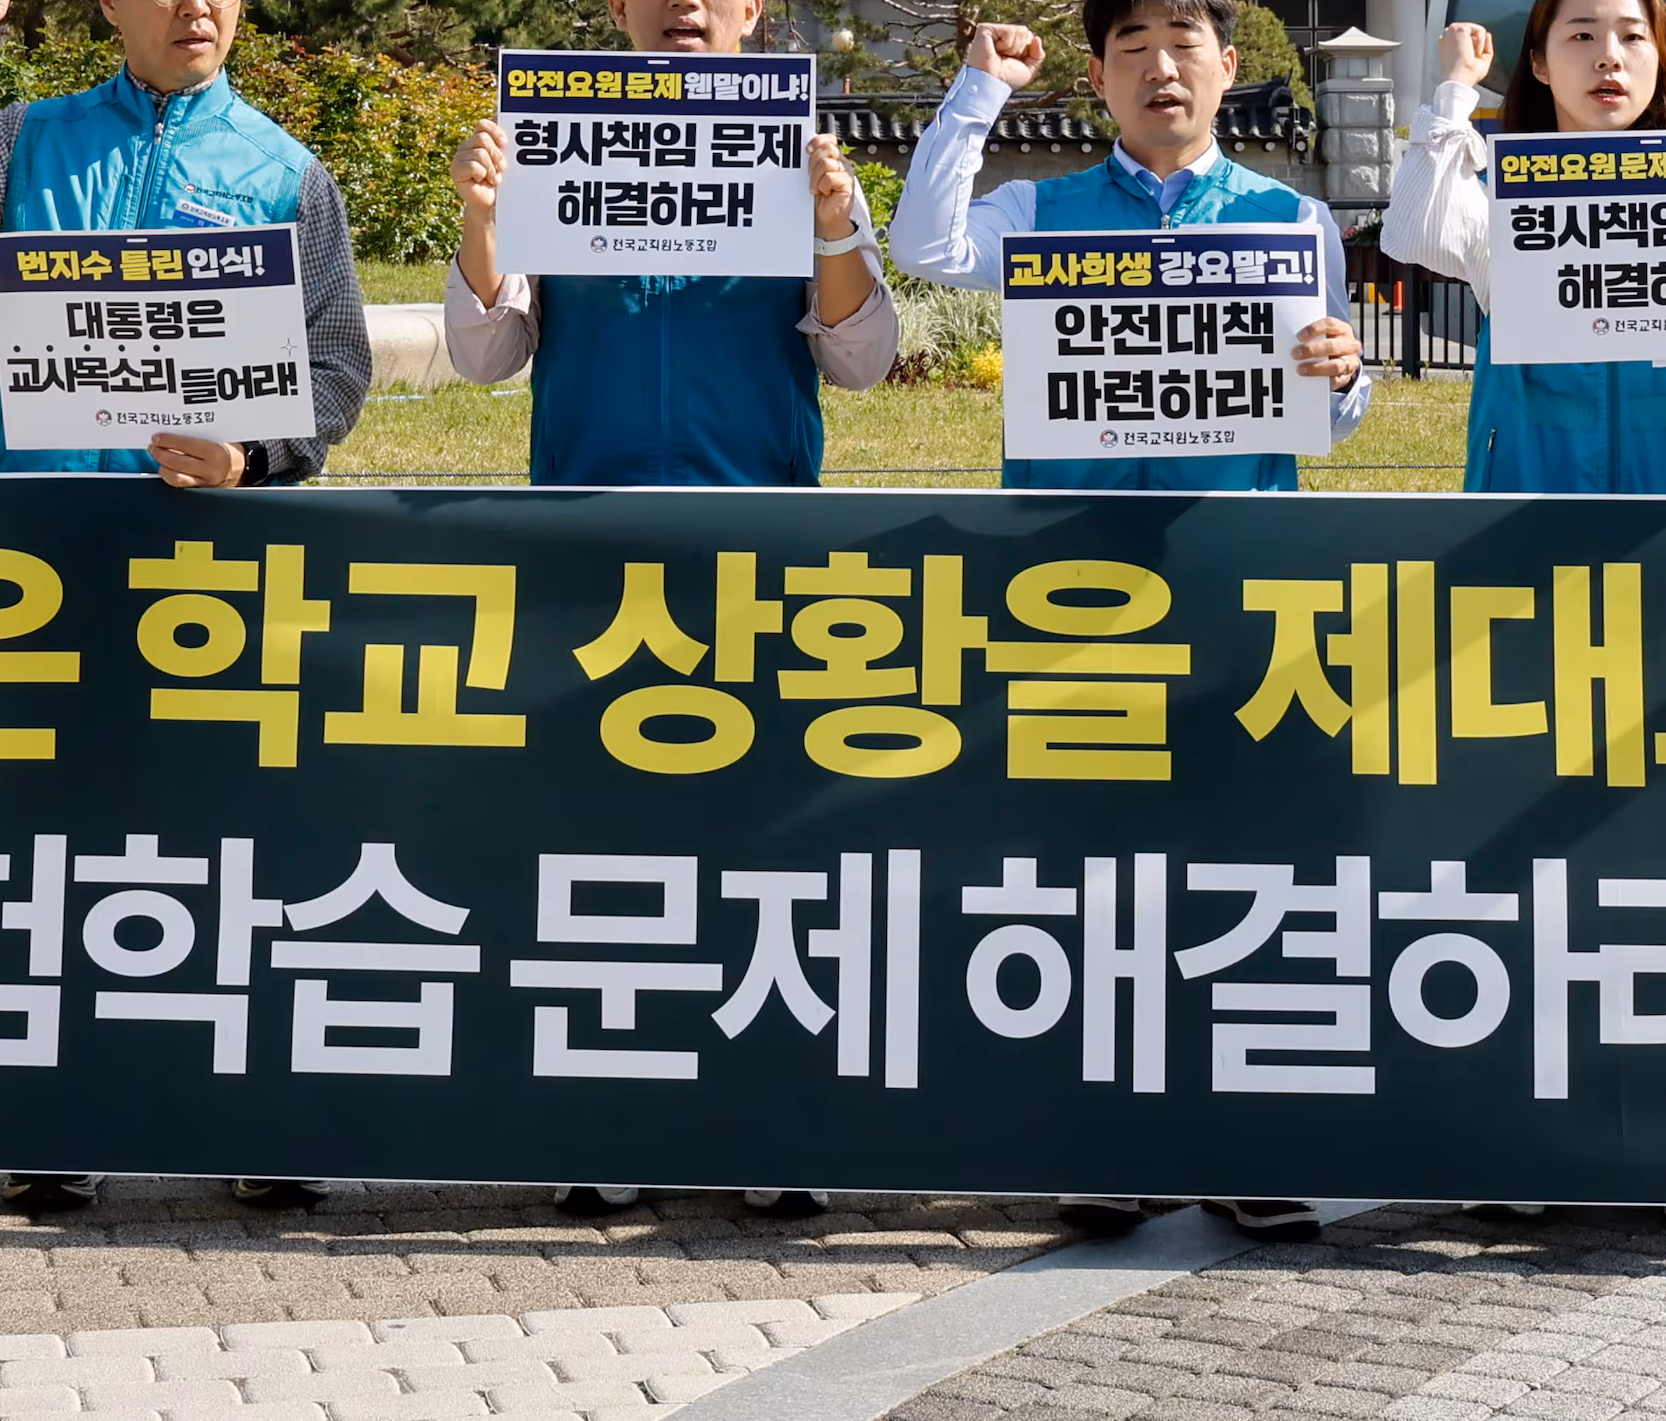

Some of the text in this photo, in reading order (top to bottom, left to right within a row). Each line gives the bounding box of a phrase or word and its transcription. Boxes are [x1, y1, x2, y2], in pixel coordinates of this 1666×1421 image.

[684, 72, 810, 102] 웬말이냐!
[514, 120, 803, 169] 형사책임 문제
[558, 180, 755, 228] 해결하라!
[16, 245, 266, 281] 번지수 틀린 인식!
[613, 239, 718, 253] 전국교직원노동조합
[1009, 250, 1315, 287] 교사희생 강요말고!
[66, 299, 226, 340] 대통령은
[1055, 302, 1275, 356] 안전대책
[7, 357, 299, 405] 교사목소리 들어라!
[1047, 368, 1284, 421] 마련하라!
[117, 411, 215, 426] 전국교직원노동조합
[1124, 430, 1235, 446] 전국교직원노동조합
[127, 539, 528, 769] 학교
[572, 550, 1192, 781] 상황을
[509, 848, 924, 1090] 문제
